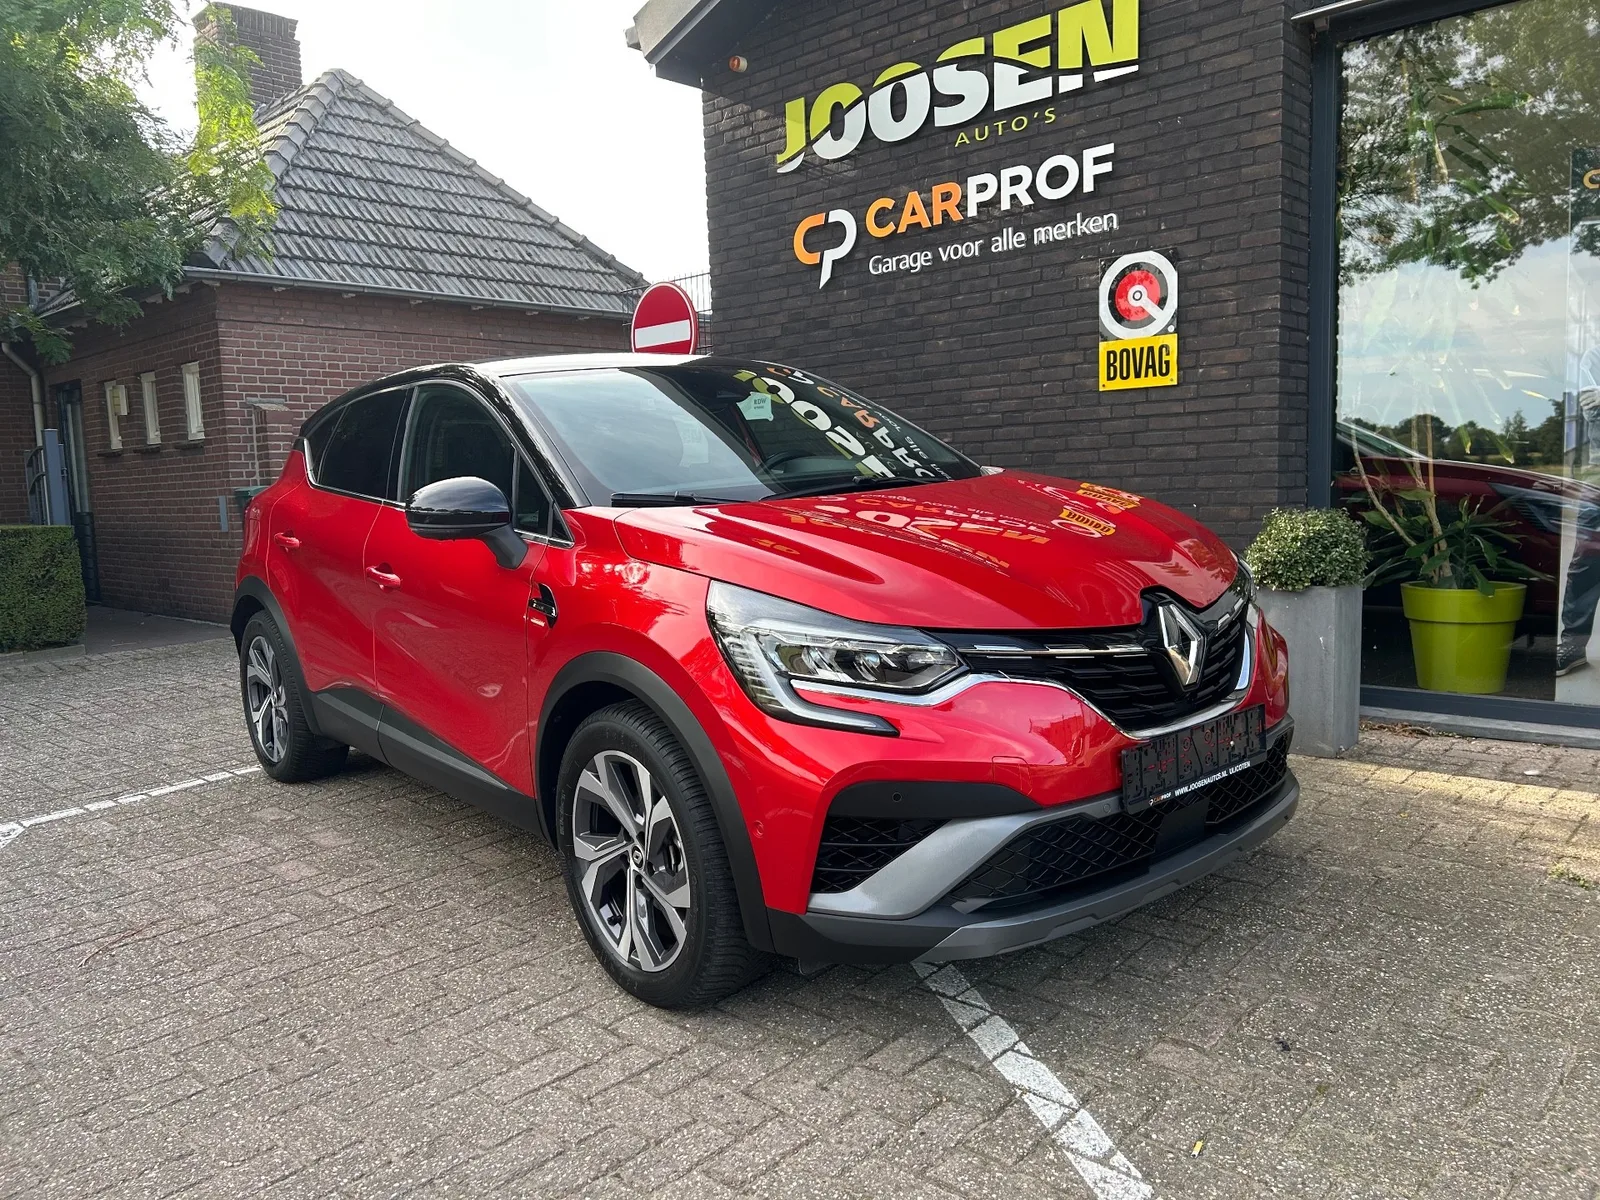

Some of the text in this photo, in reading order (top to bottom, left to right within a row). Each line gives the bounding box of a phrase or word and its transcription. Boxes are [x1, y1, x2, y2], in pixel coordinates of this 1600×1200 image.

[776, 0, 1139, 173] JOOSEN
[954, 107, 1057, 148] AUTO'S
[865, 143, 1115, 238] CARPROF
[869, 212, 1118, 275] Garage voor alle merken
[1106, 343, 1171, 382] BOVAG
